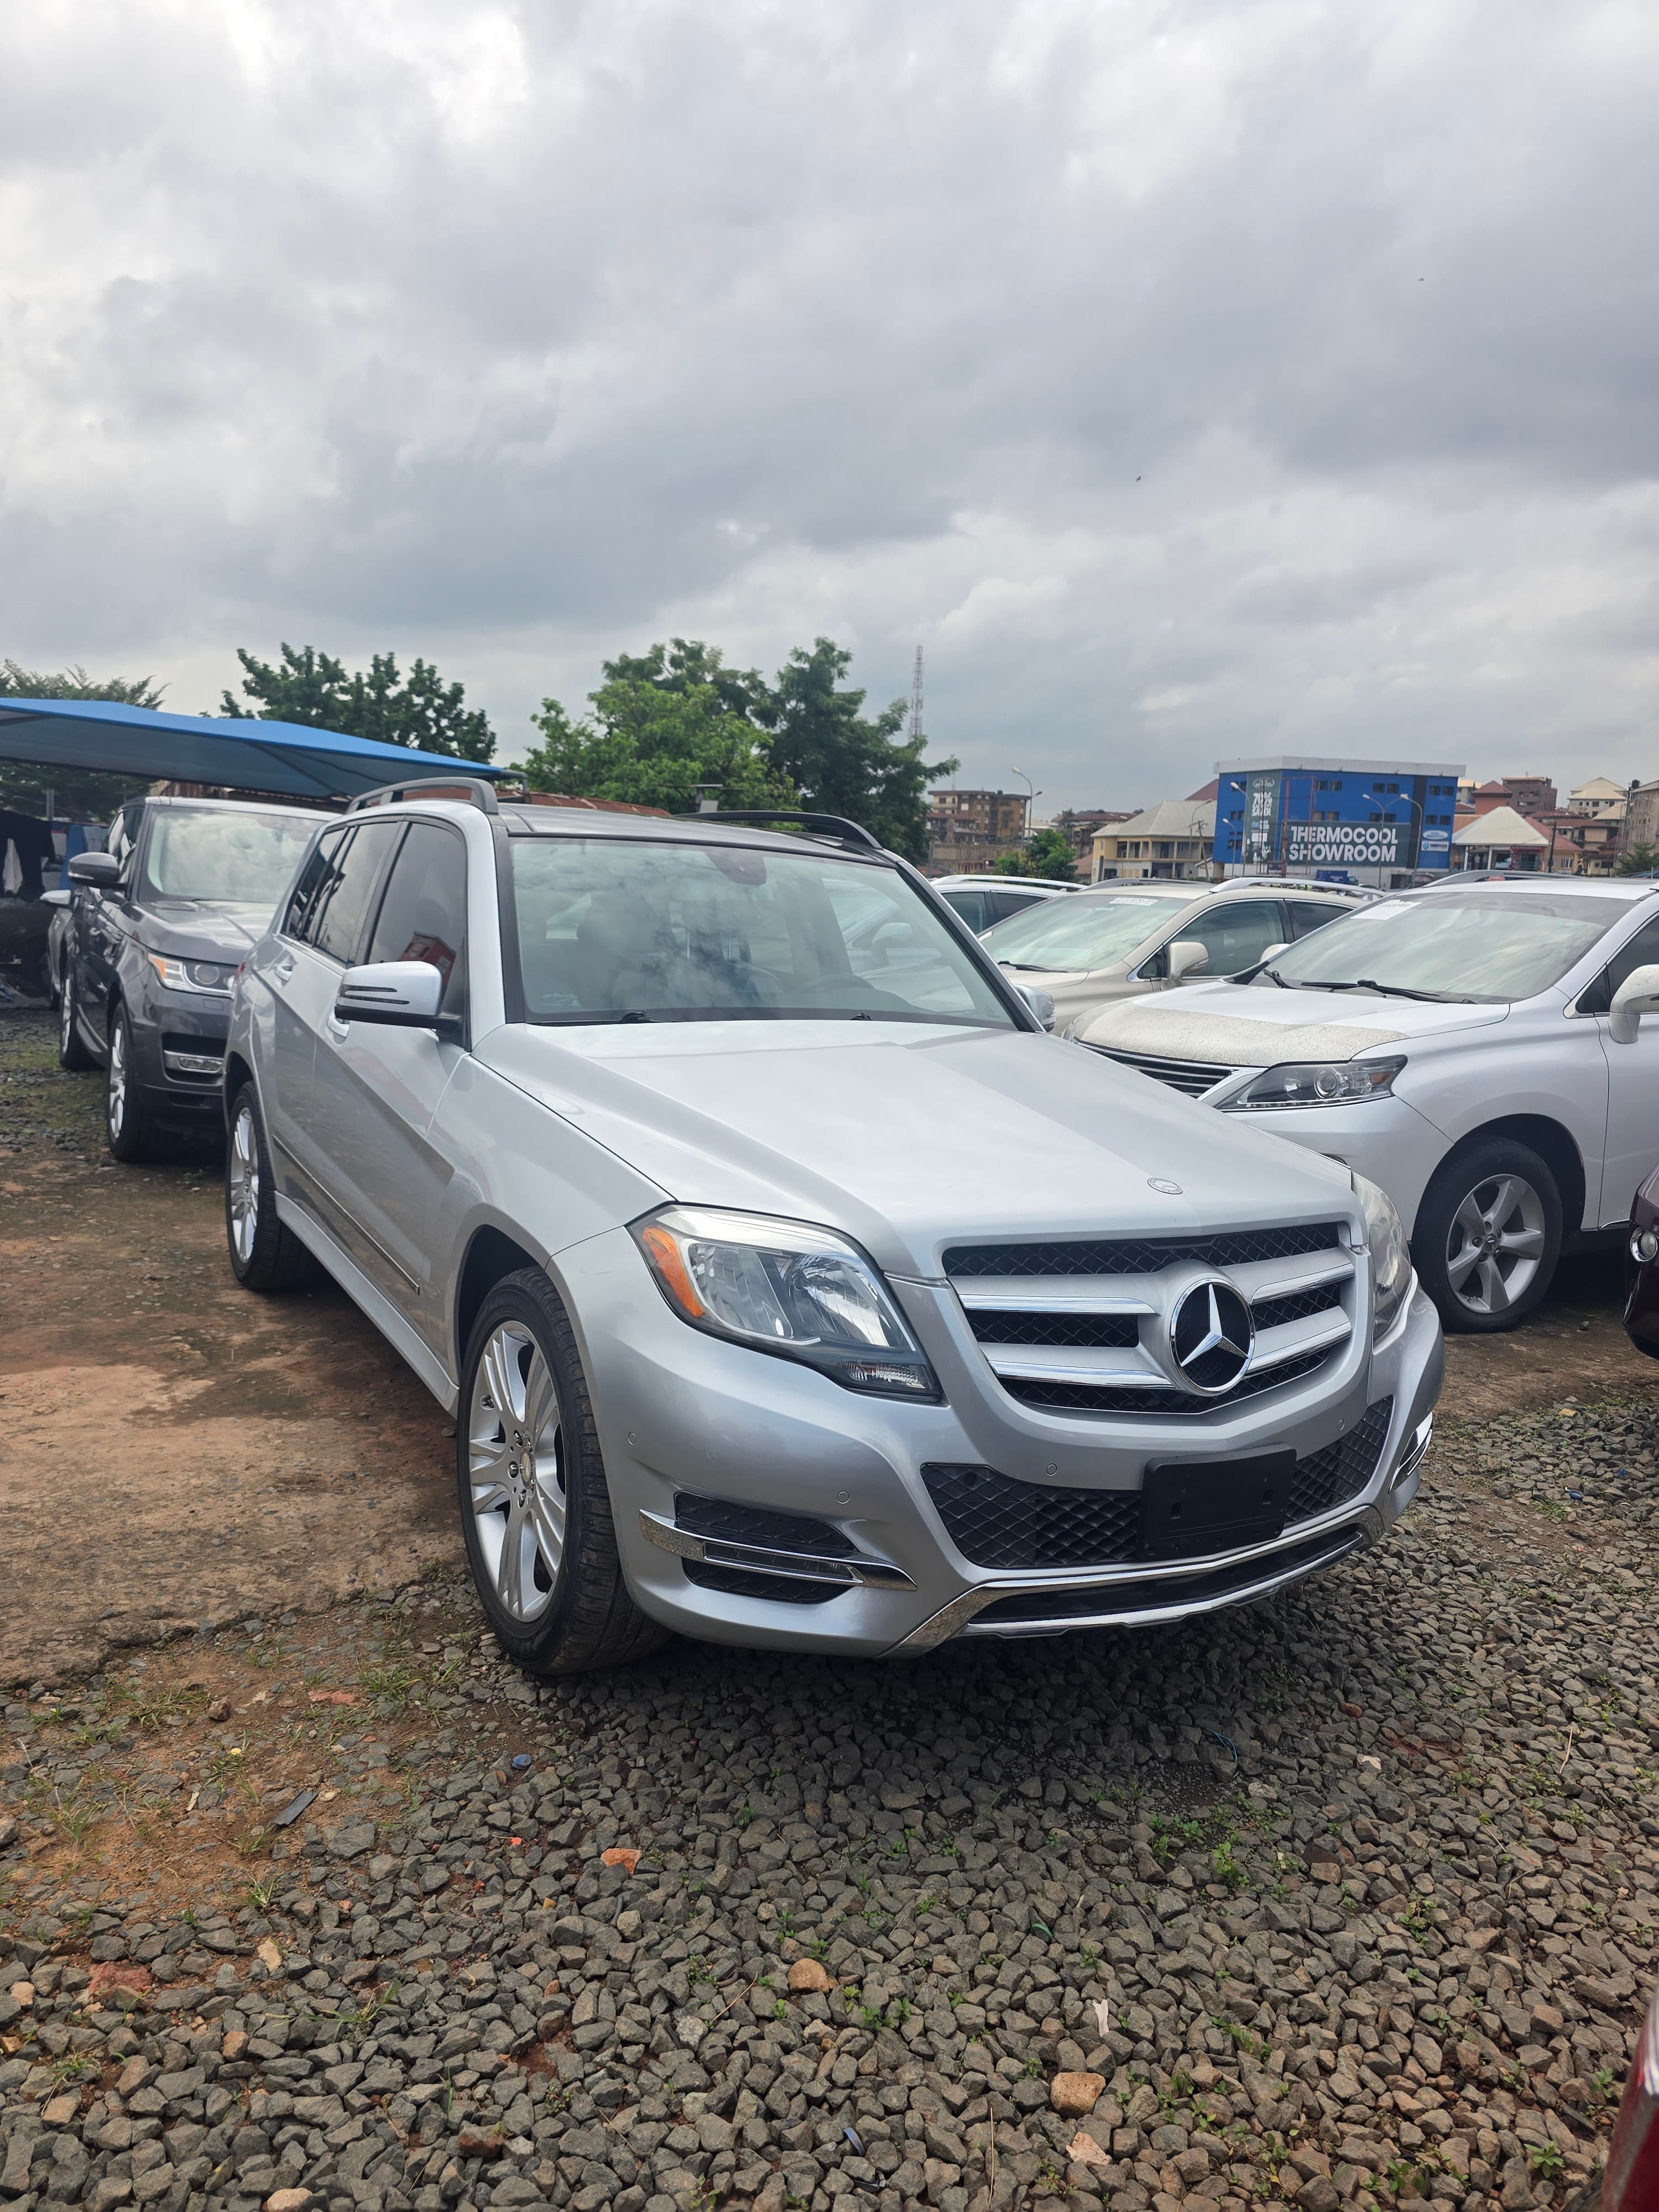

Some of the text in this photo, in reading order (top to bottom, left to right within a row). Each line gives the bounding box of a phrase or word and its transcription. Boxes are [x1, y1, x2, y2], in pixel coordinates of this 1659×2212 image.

[1253, 792, 1273, 805] 70%
[1291, 826, 1399, 844] THERMOCOOL
[1288, 843, 1396, 862] SHOWROOM
